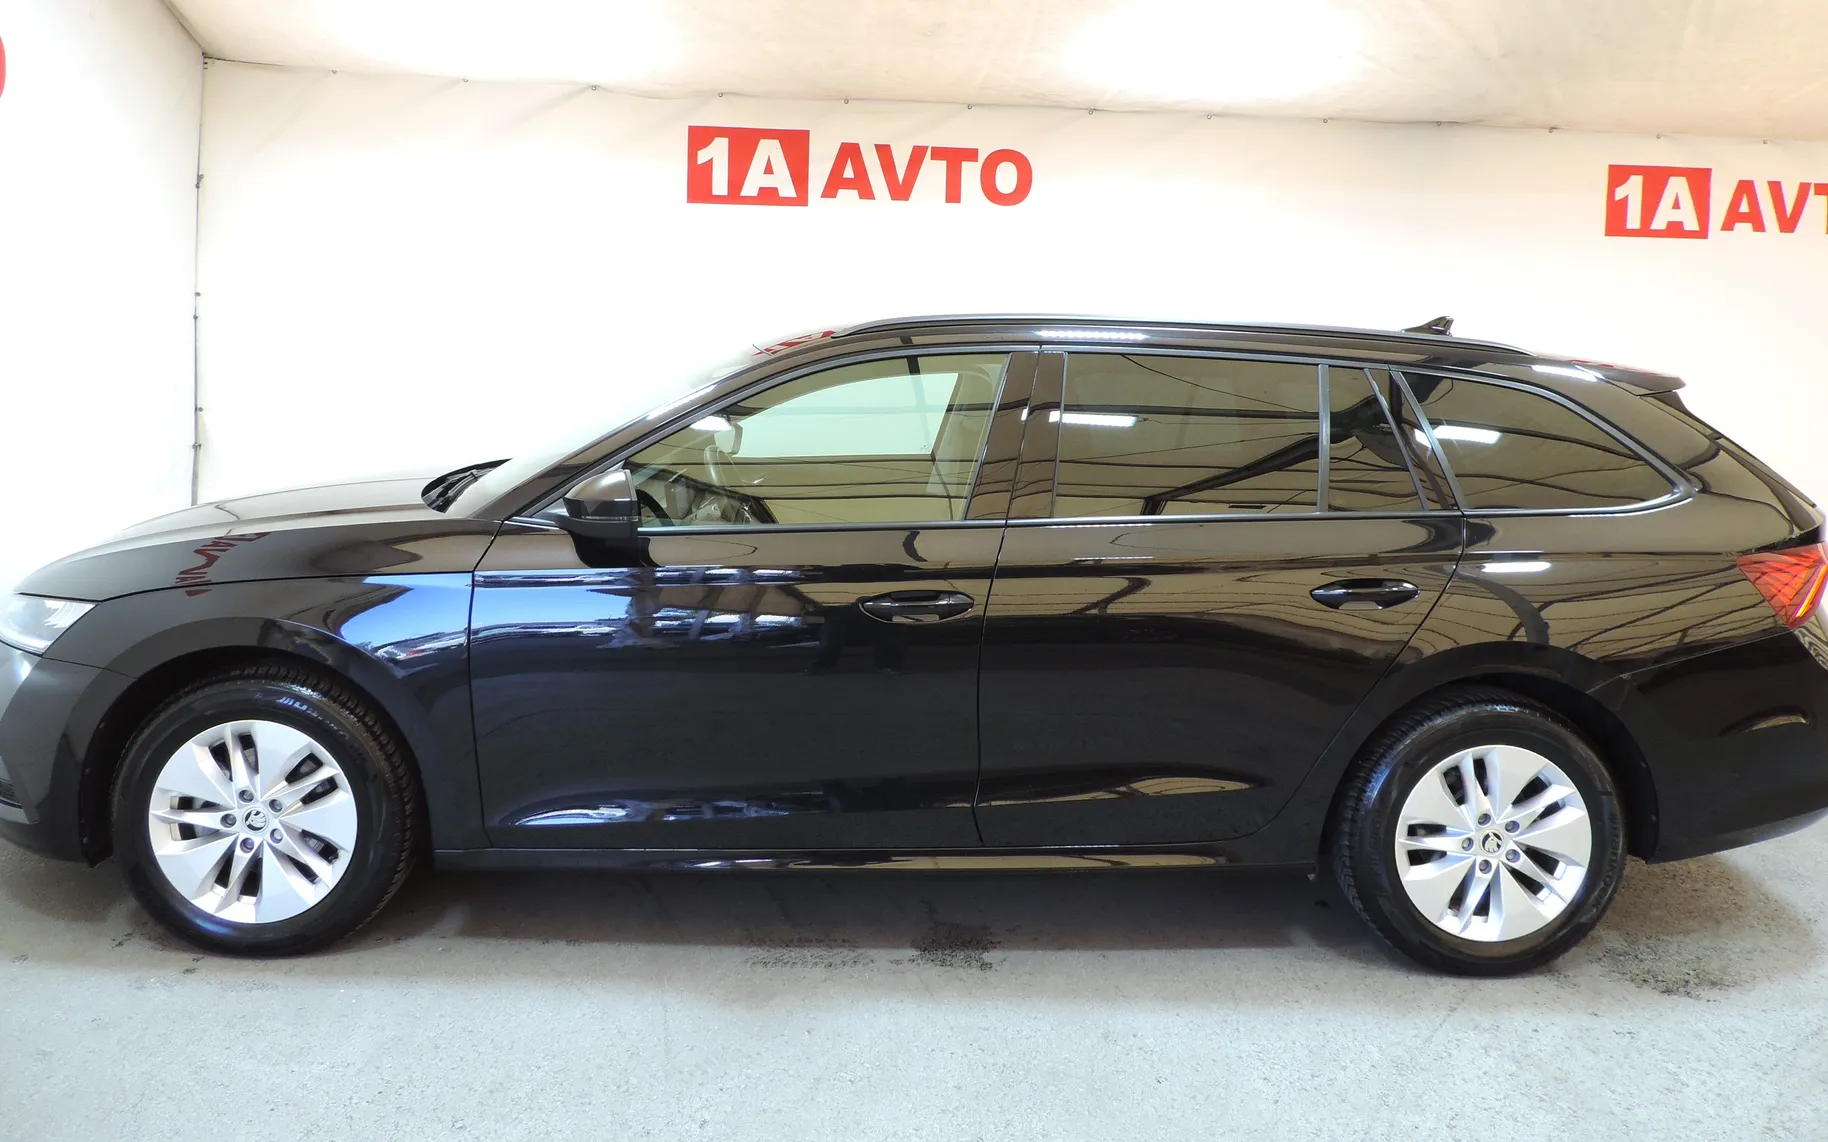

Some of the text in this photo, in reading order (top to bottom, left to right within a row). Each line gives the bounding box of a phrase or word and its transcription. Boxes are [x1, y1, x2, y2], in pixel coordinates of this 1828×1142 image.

[696, 136, 1033, 206] 1A AVTO
[1613, 173, 1702, 232] 1A
